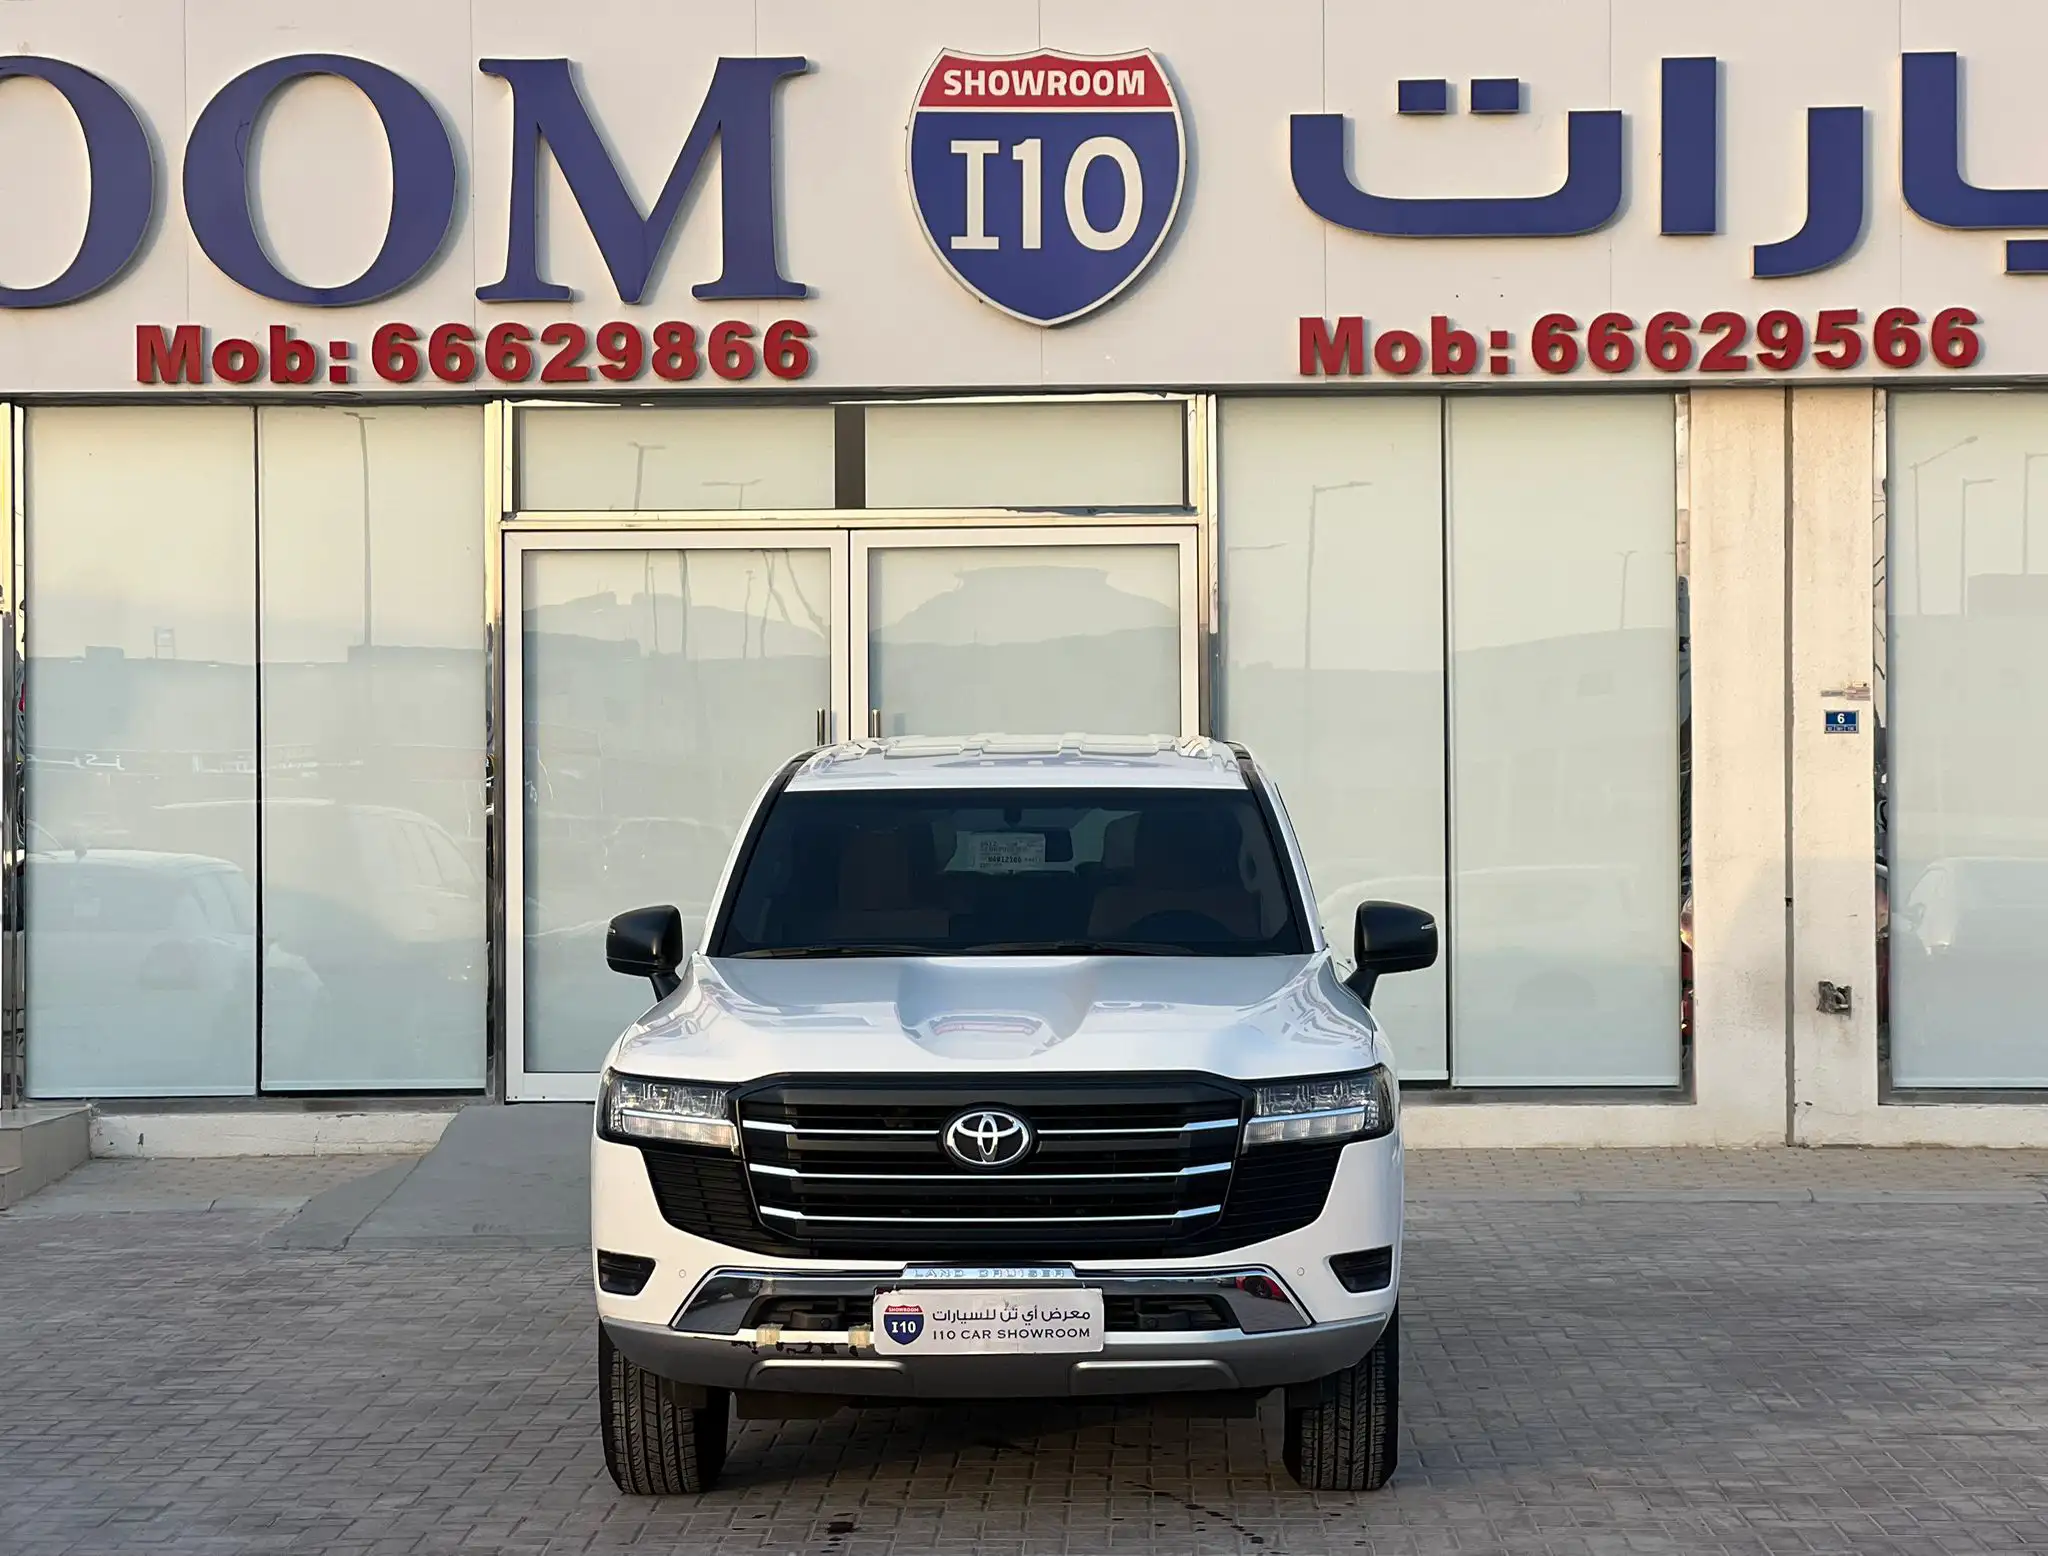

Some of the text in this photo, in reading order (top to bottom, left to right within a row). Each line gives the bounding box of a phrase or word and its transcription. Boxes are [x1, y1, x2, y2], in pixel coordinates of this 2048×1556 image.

[943, 69, 1145, 96] SHOWROOM
[950, 136, 1143, 251] I10
[1531, 308, 1980, 373] 66629566
[370, 319, 812, 383] 66629866
[1837, 713, 1845, 724] 6
[913, 1269, 1065, 1278] LAND CRUISER
[932, 1308, 996, 1324] للسيارات
[1021, 1305, 1038, 1326] أي
[1041, 1307, 1091, 1322] معرض
[891, 1321, 916, 1333] I10
[961, 1329, 992, 1340] CAR
[997, 1328, 1090, 1339] SHOWROOM
